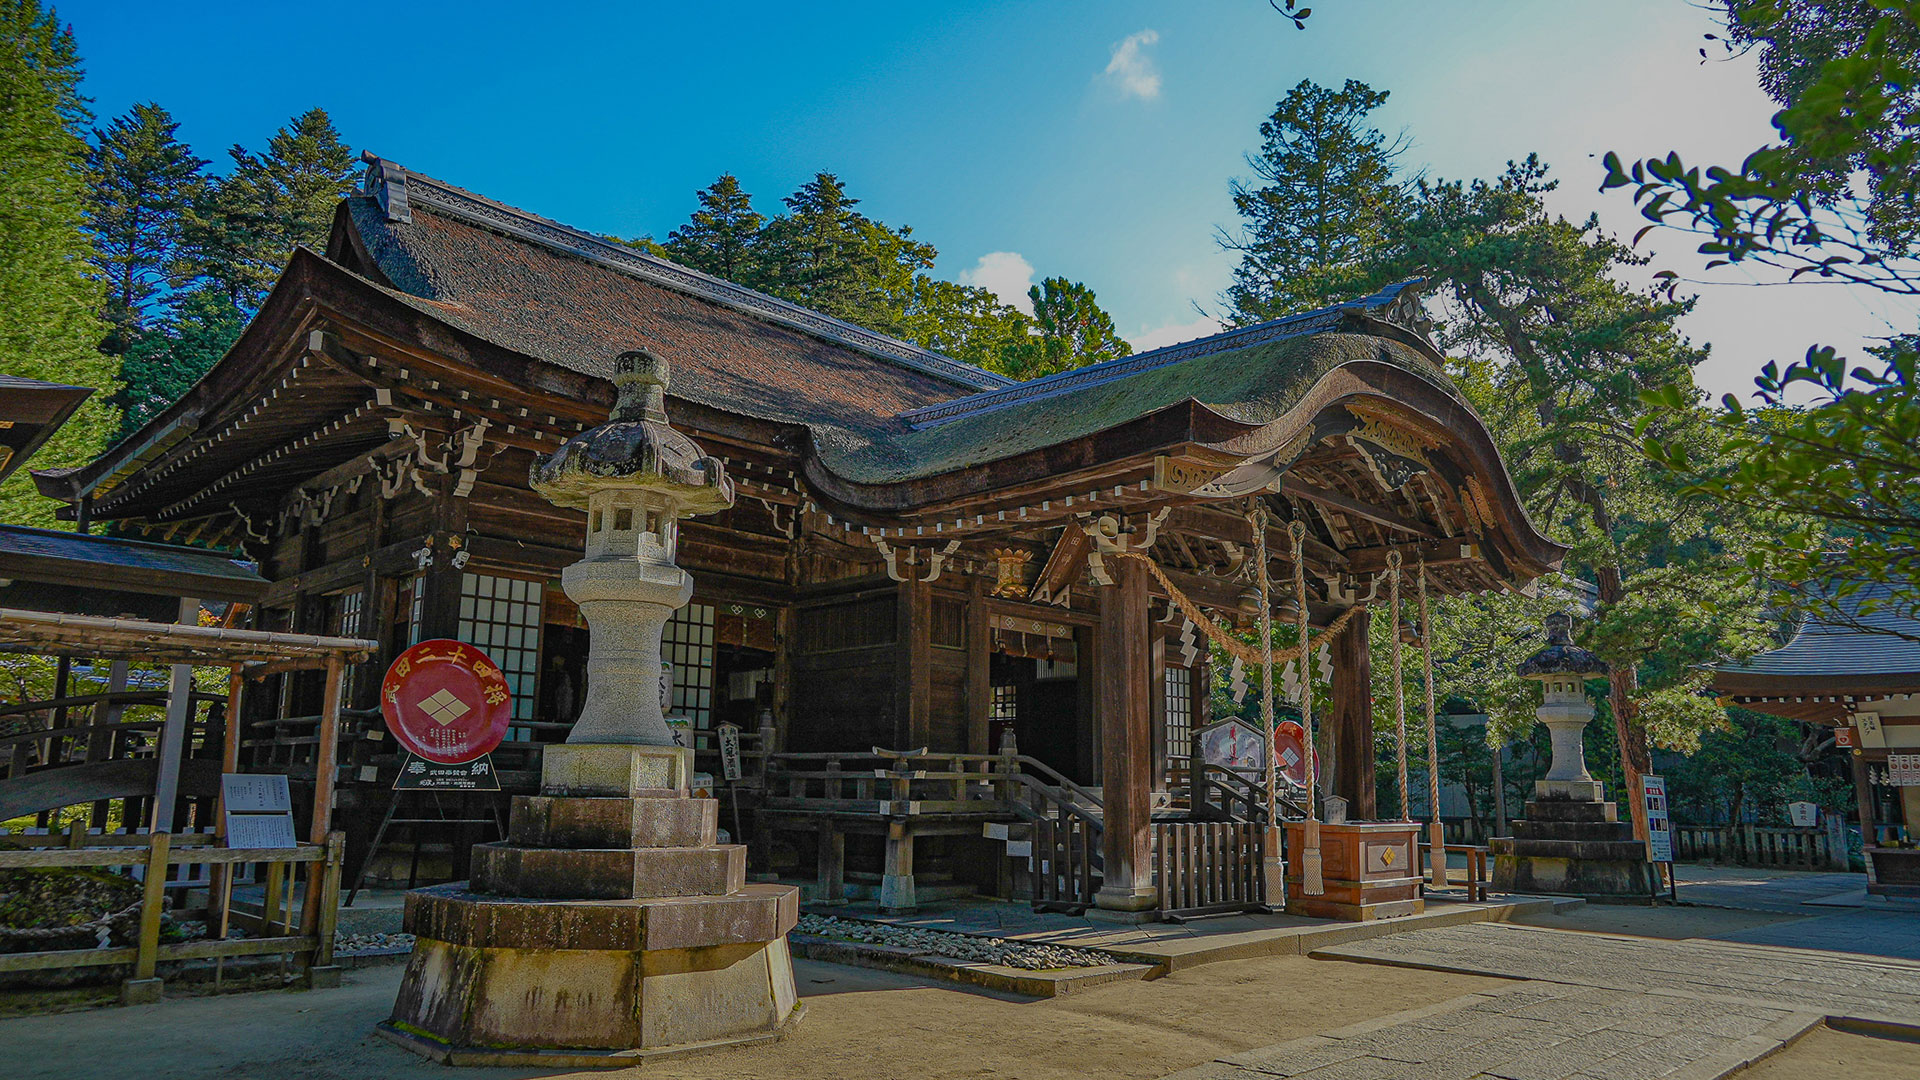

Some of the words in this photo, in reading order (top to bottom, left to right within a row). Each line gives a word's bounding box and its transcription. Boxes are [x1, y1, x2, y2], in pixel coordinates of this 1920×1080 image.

[384, 645, 508, 706] 武田二十四将
